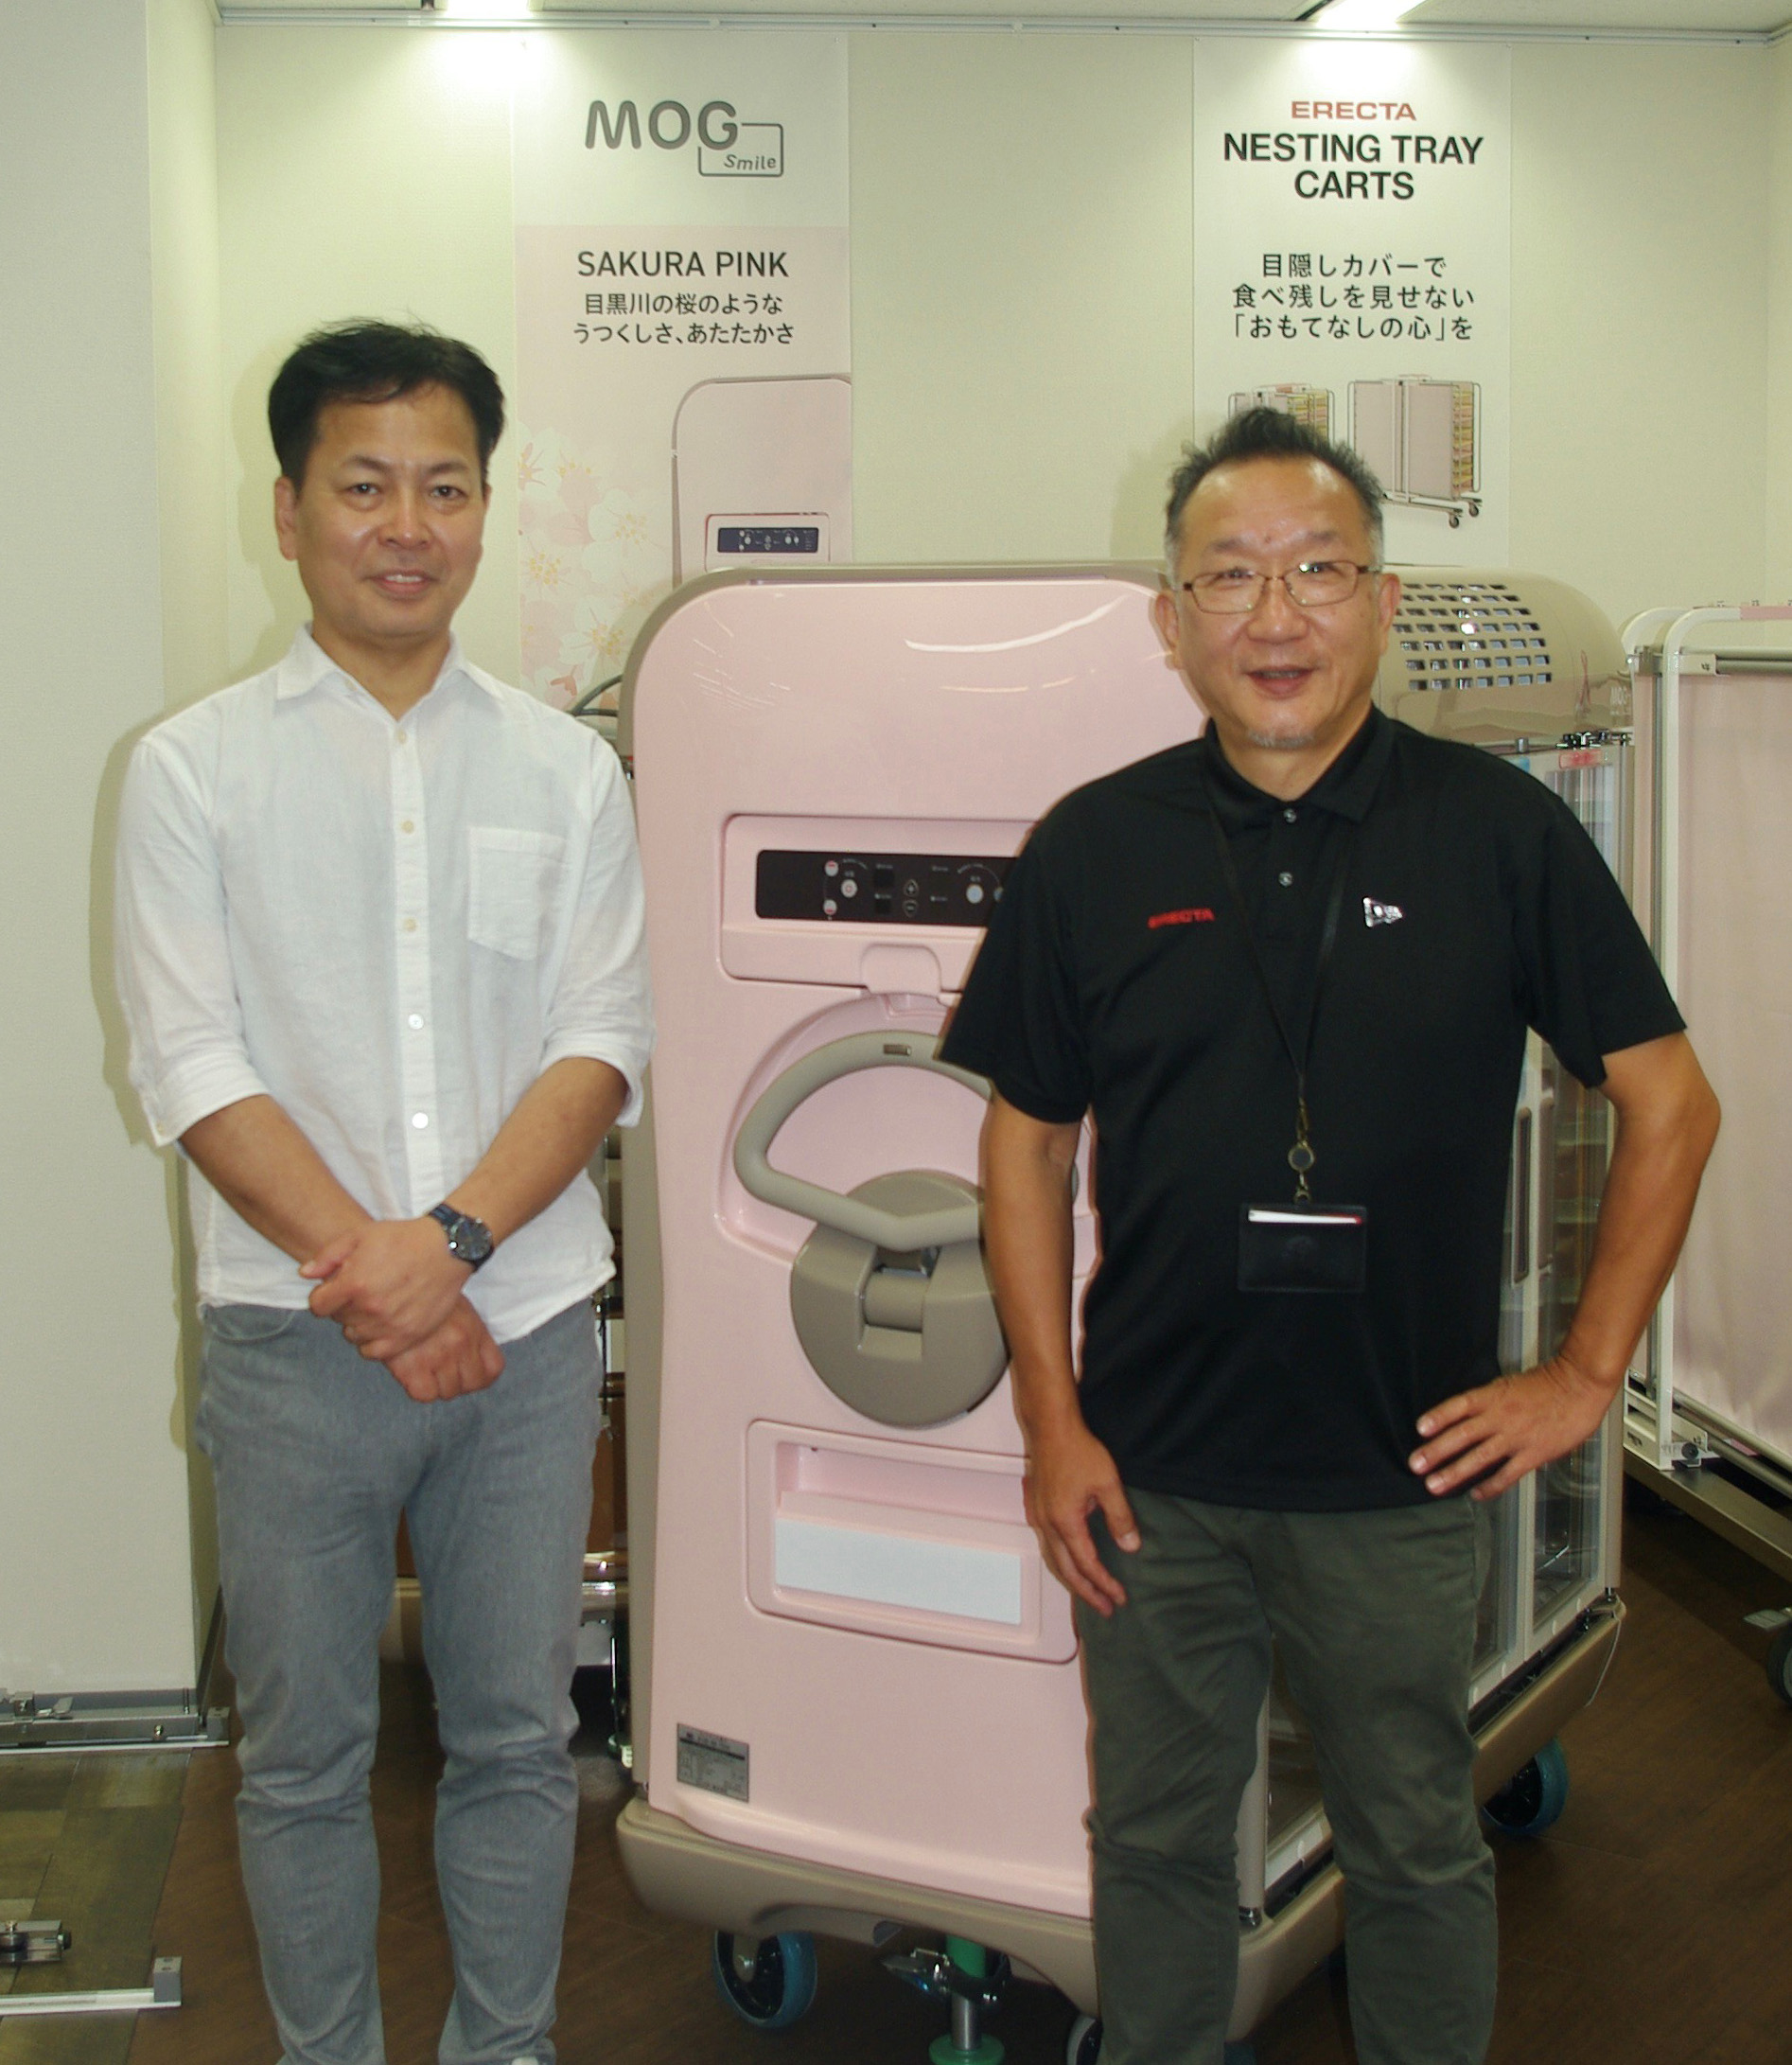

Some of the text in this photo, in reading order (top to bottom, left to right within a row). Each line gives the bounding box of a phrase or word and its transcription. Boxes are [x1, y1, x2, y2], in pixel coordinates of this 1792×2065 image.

[1291, 100, 1417, 121] ERECTA
[584, 99, 739, 150] MOG
[723, 153, 777, 170] Smile
[1223, 132, 1485, 166] NESTING TRAY
[1293, 169, 1415, 201] CARTS
[577, 250, 789, 278] SAKURA PINK
[1262, 253, 1447, 279] 目隠しカバーで
[585, 291, 783, 316] 目黒川の桜のような
[1232, 283, 1475, 310] 食べ残しを見せない
[573, 322, 795, 345] うつくしさ、あたたかさ
[1234, 312, 1473, 342] 「おもてなしの心」を
